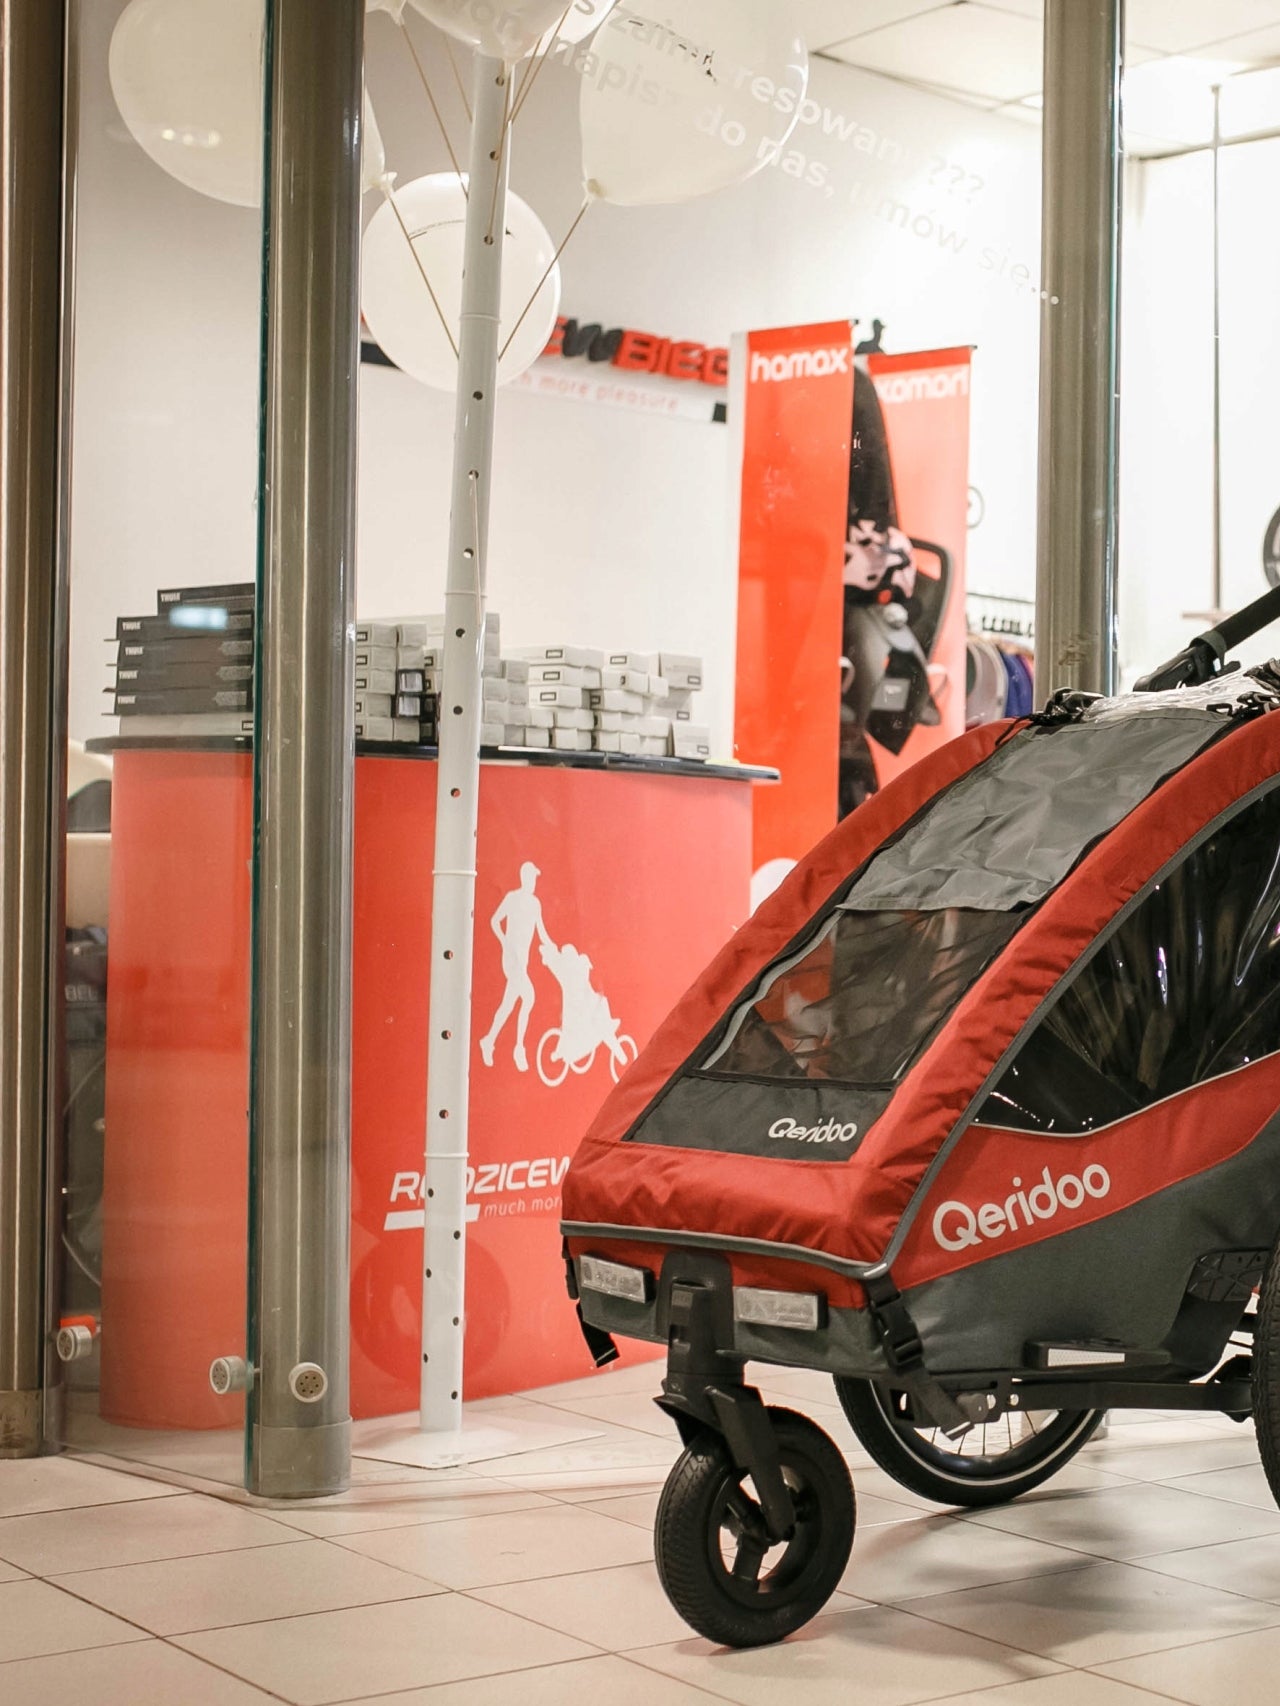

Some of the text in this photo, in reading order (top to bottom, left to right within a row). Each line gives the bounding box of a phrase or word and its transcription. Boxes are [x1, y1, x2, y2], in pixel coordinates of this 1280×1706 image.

[768, 1117, 857, 1143] Qeridoo
[484, 1196, 563, 1218] much mor
[932, 1164, 1111, 1252] Qeridoo
